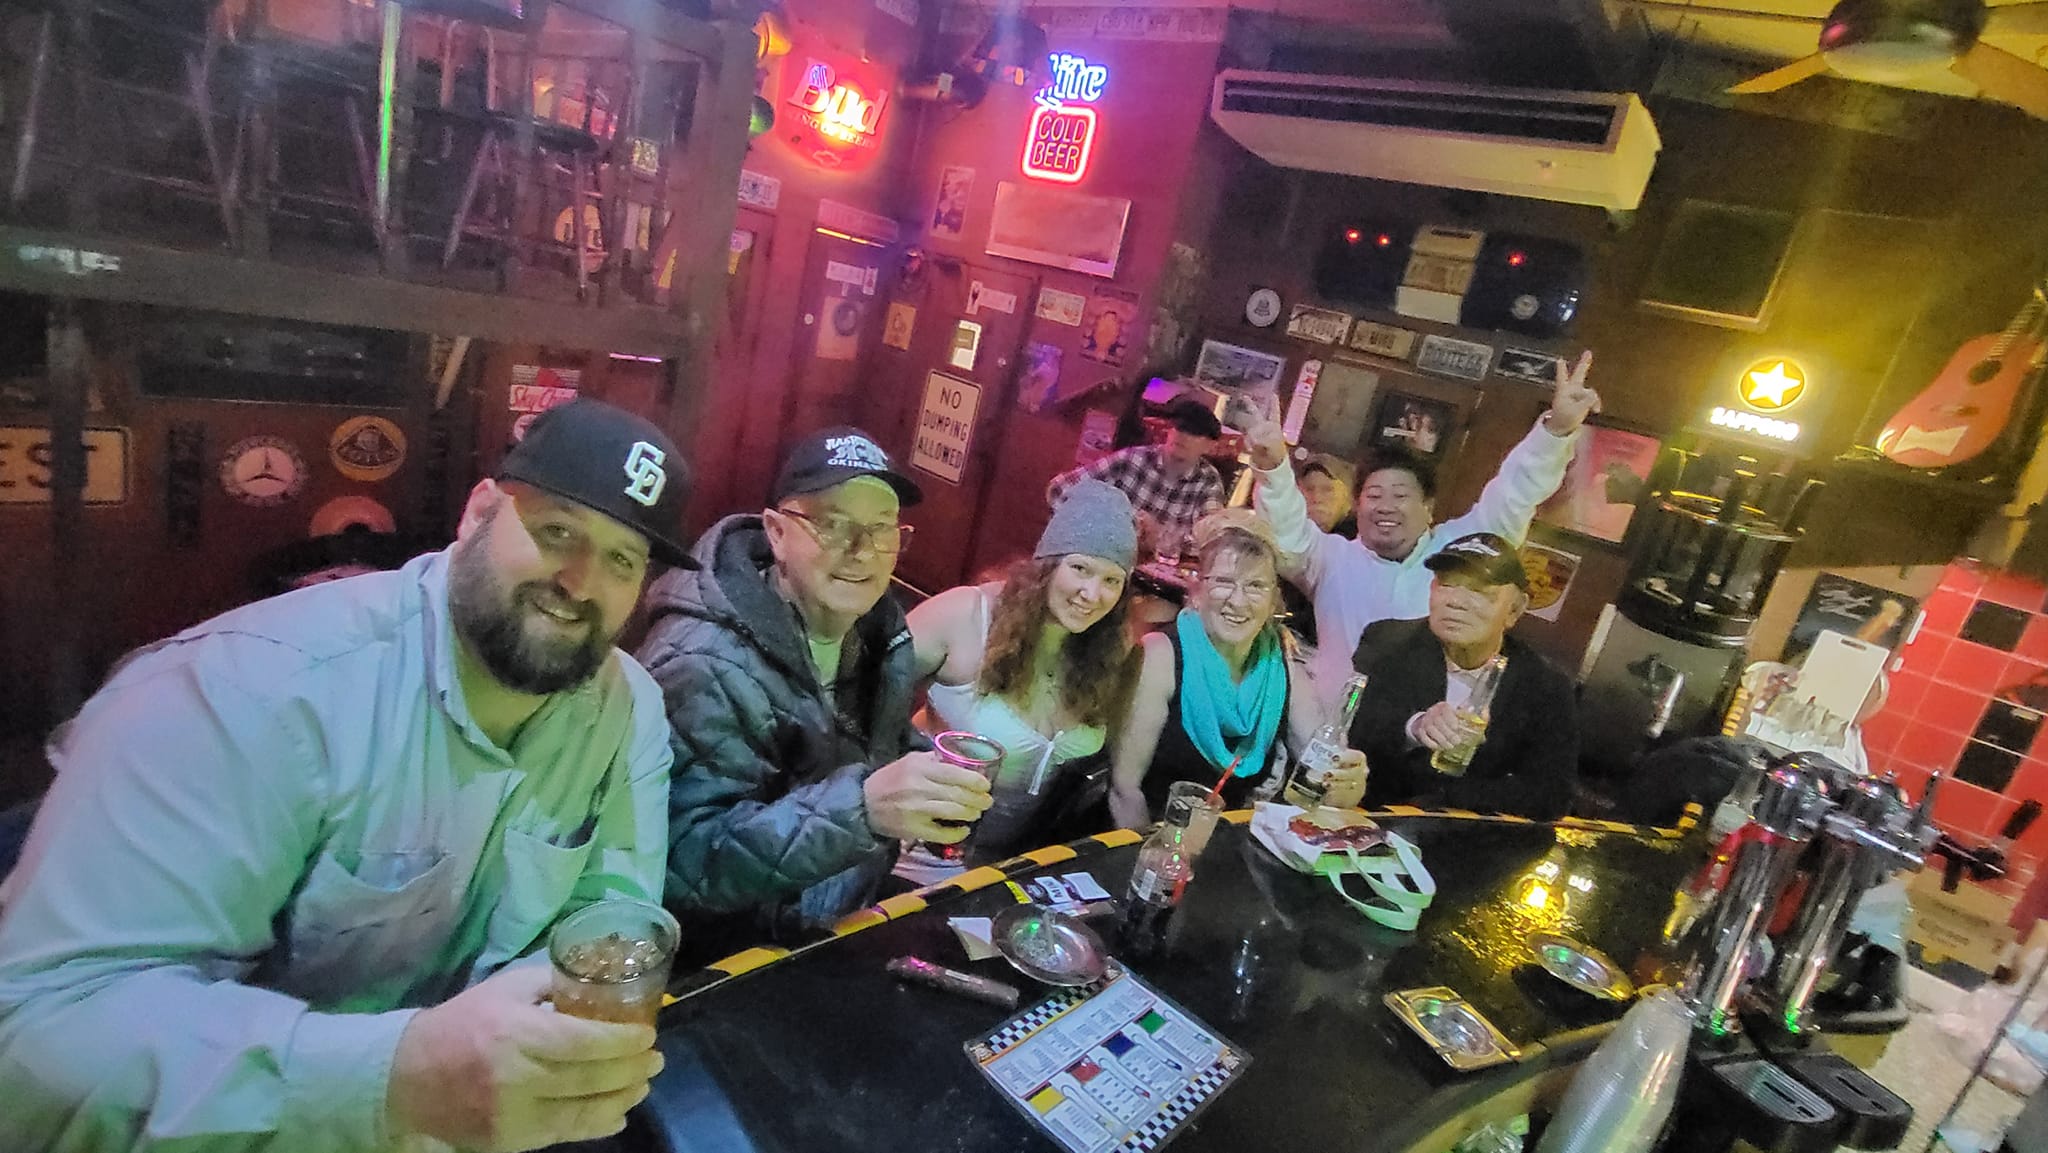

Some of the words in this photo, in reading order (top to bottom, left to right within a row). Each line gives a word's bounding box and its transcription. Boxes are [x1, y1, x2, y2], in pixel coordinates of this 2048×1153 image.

[785, 57, 889, 136] Bud
[1038, 114, 1088, 143] COLD
[1031, 140, 1081, 170] BEER
[940, 387, 962, 410] NO
[923, 408, 969, 442] DUMPING
[918, 436, 964, 469] ALLOWED
